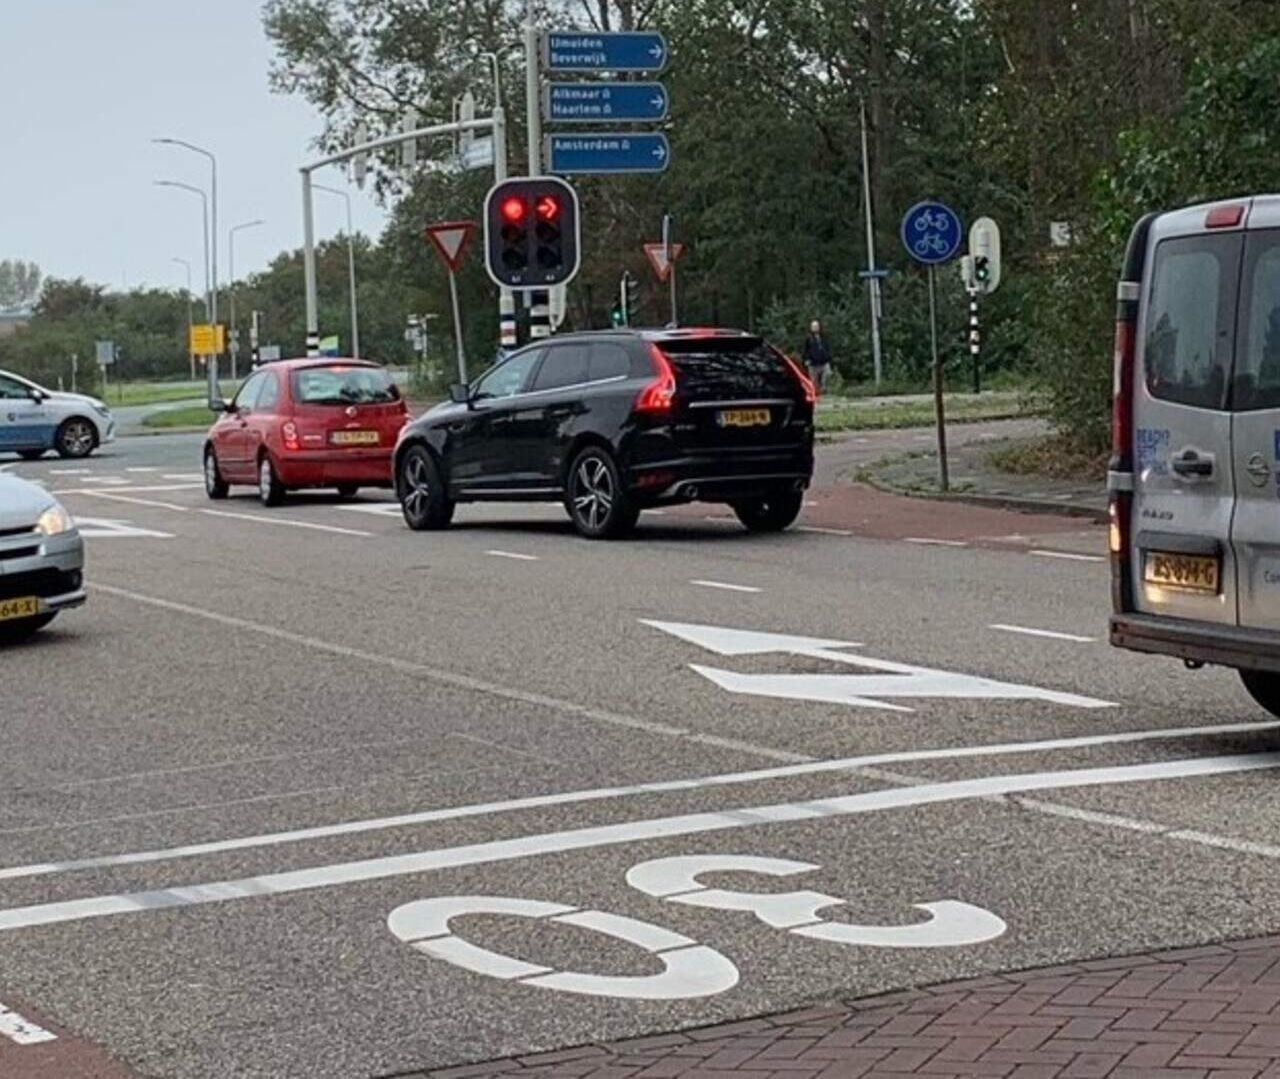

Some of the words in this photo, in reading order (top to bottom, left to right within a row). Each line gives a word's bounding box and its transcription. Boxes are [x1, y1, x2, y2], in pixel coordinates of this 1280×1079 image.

[551, 52, 607, 64] Beverwijk
[553, 88, 600, 99] Alkmaar
[553, 104, 601, 114] Haarlem
[555, 140, 619, 150] Amsterdam
